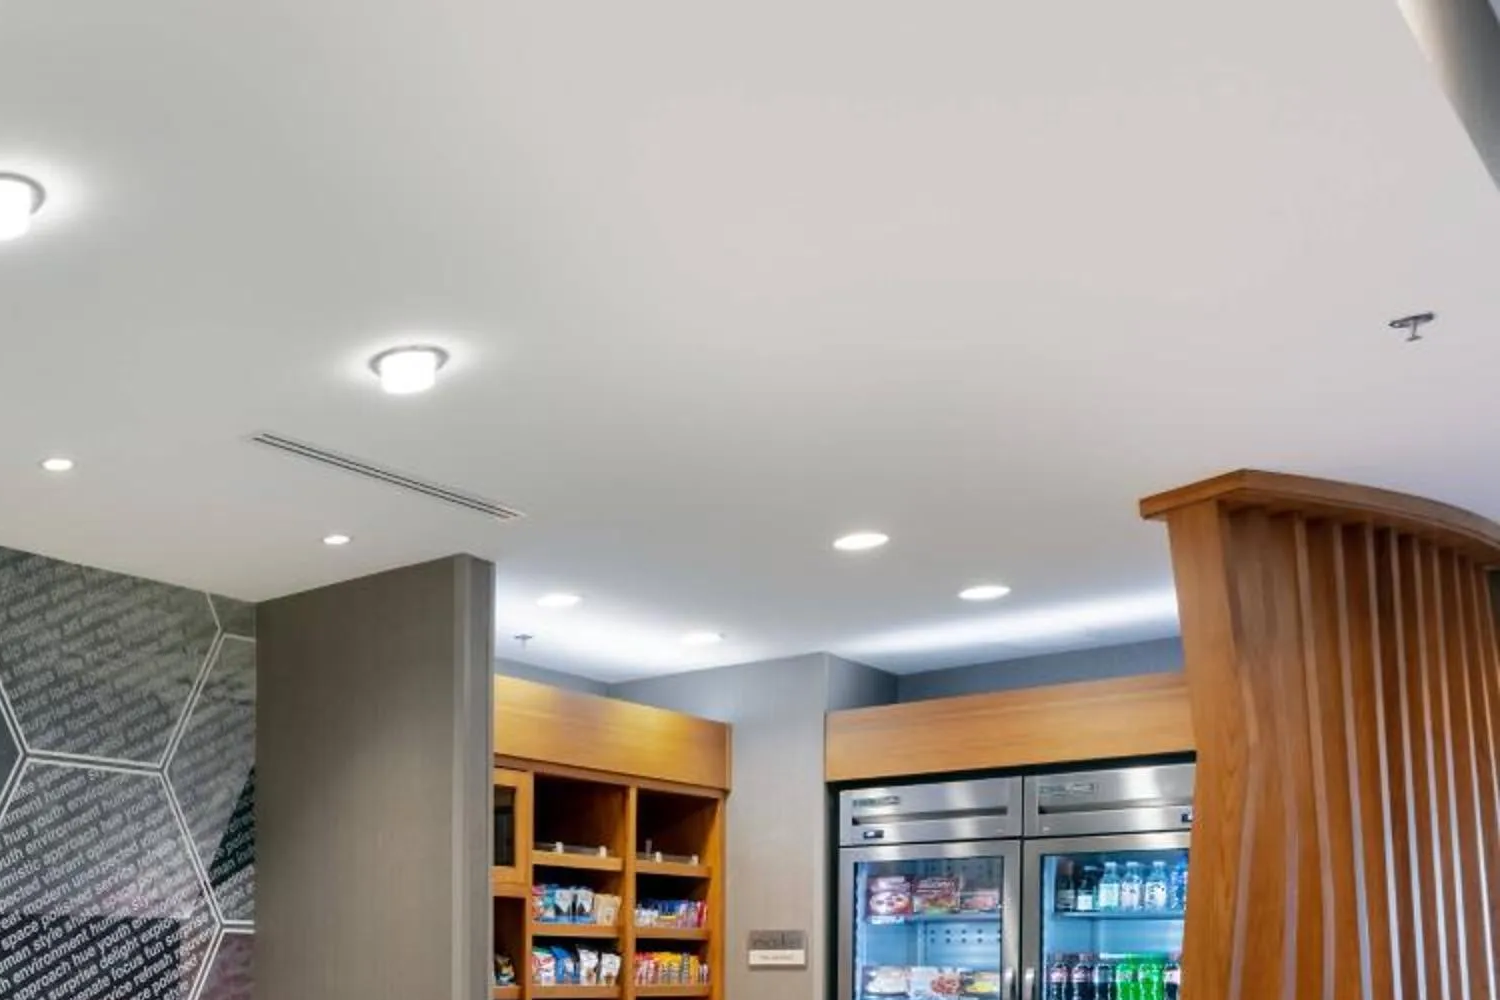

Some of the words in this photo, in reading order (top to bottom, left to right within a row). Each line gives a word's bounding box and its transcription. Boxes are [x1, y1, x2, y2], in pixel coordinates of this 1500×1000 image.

[43, 822, 99, 866] approach
[43, 850, 84, 885] vibrant
[2, 919, 39, 950] space
[42, 884, 92, 929] polished
[24, 880, 70, 916] modern
[33, 924, 63, 950] style
[65, 902, 100, 931] shake
[72, 944, 94, 965] hue
[98, 918, 129, 954] youth
[13, 926, 88, 983] environment
[49, 961, 98, 1000] surprise
[99, 932, 138, 968] delight
[111, 951, 143, 979] focus
[144, 939, 163, 958] fun
[134, 948, 172, 985] refresh
